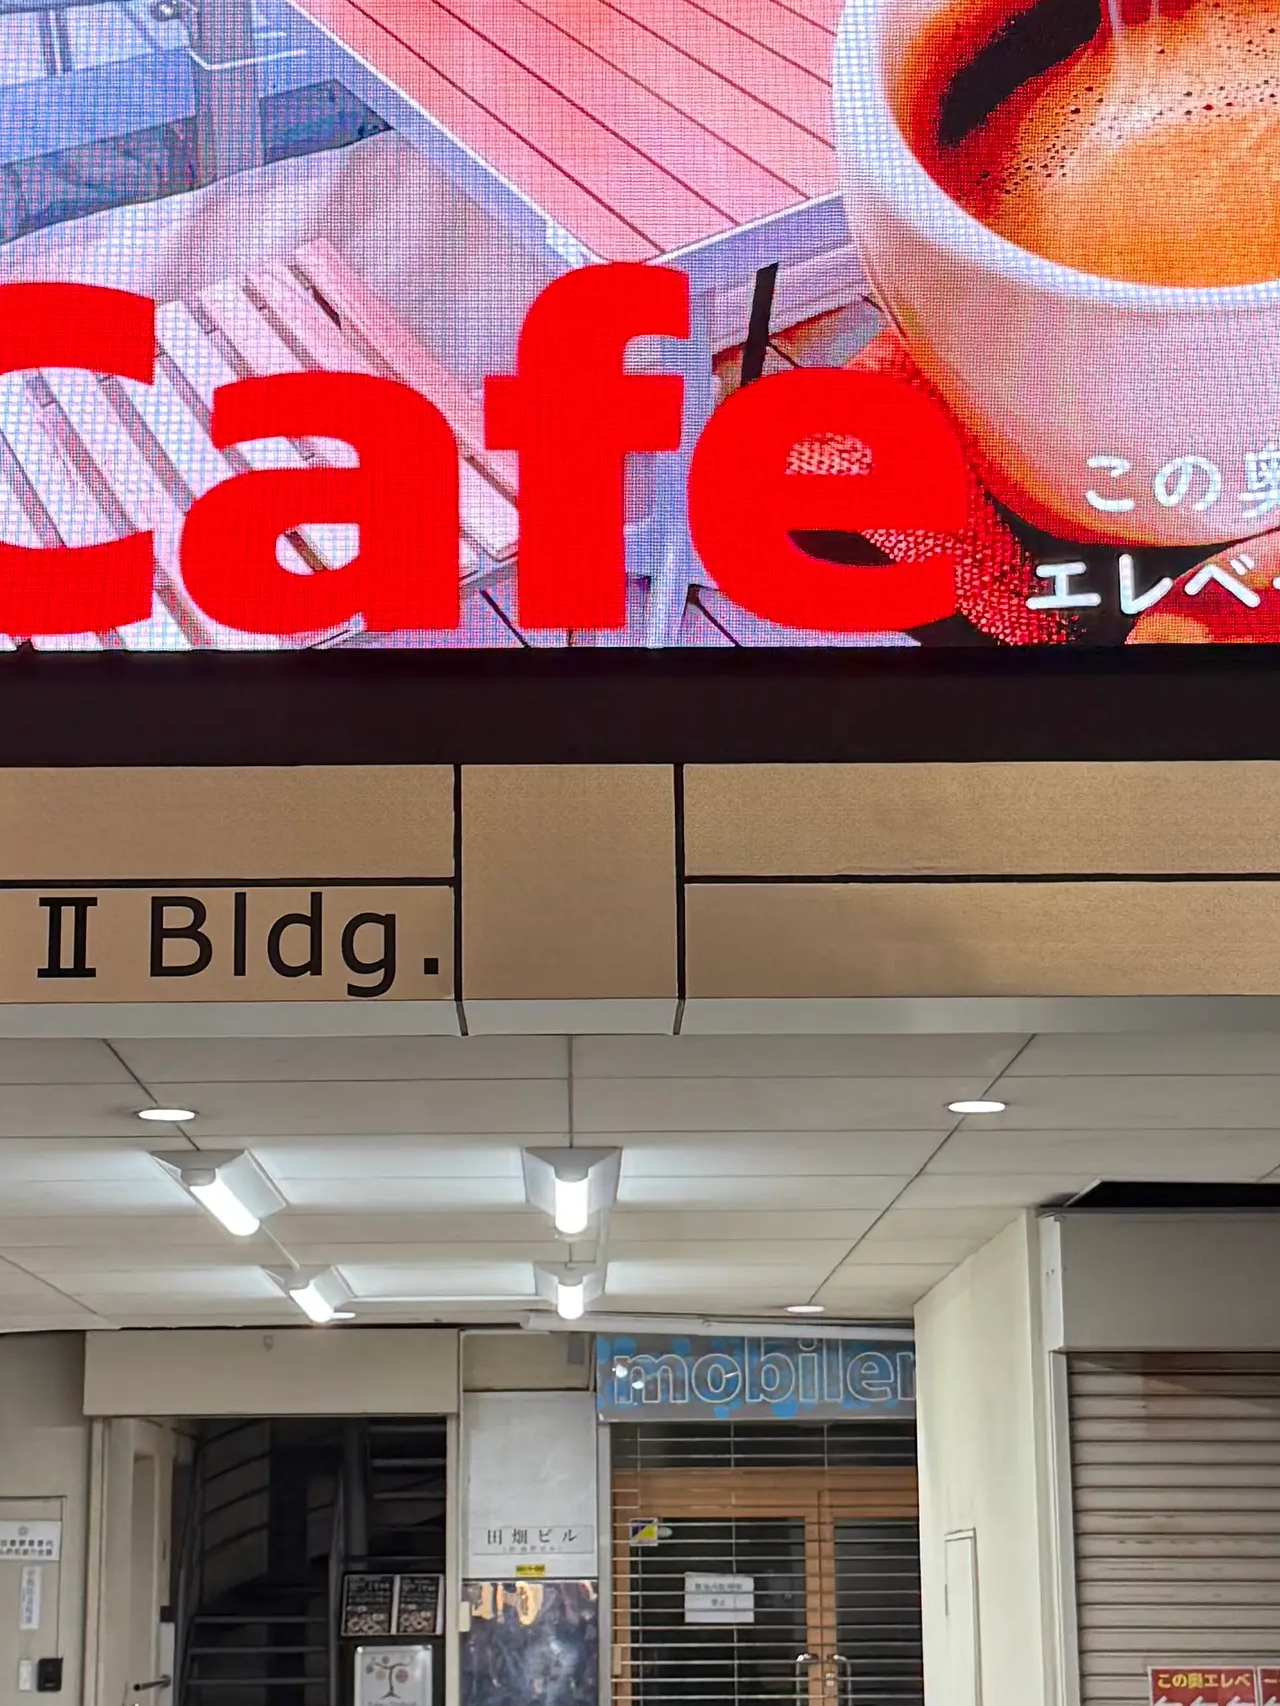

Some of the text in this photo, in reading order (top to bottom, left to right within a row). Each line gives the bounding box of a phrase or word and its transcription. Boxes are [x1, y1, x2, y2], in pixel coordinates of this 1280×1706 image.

[149, 891, 441, 998] Bldg.
[487, 1528, 579, 1546] 田畑ビル
